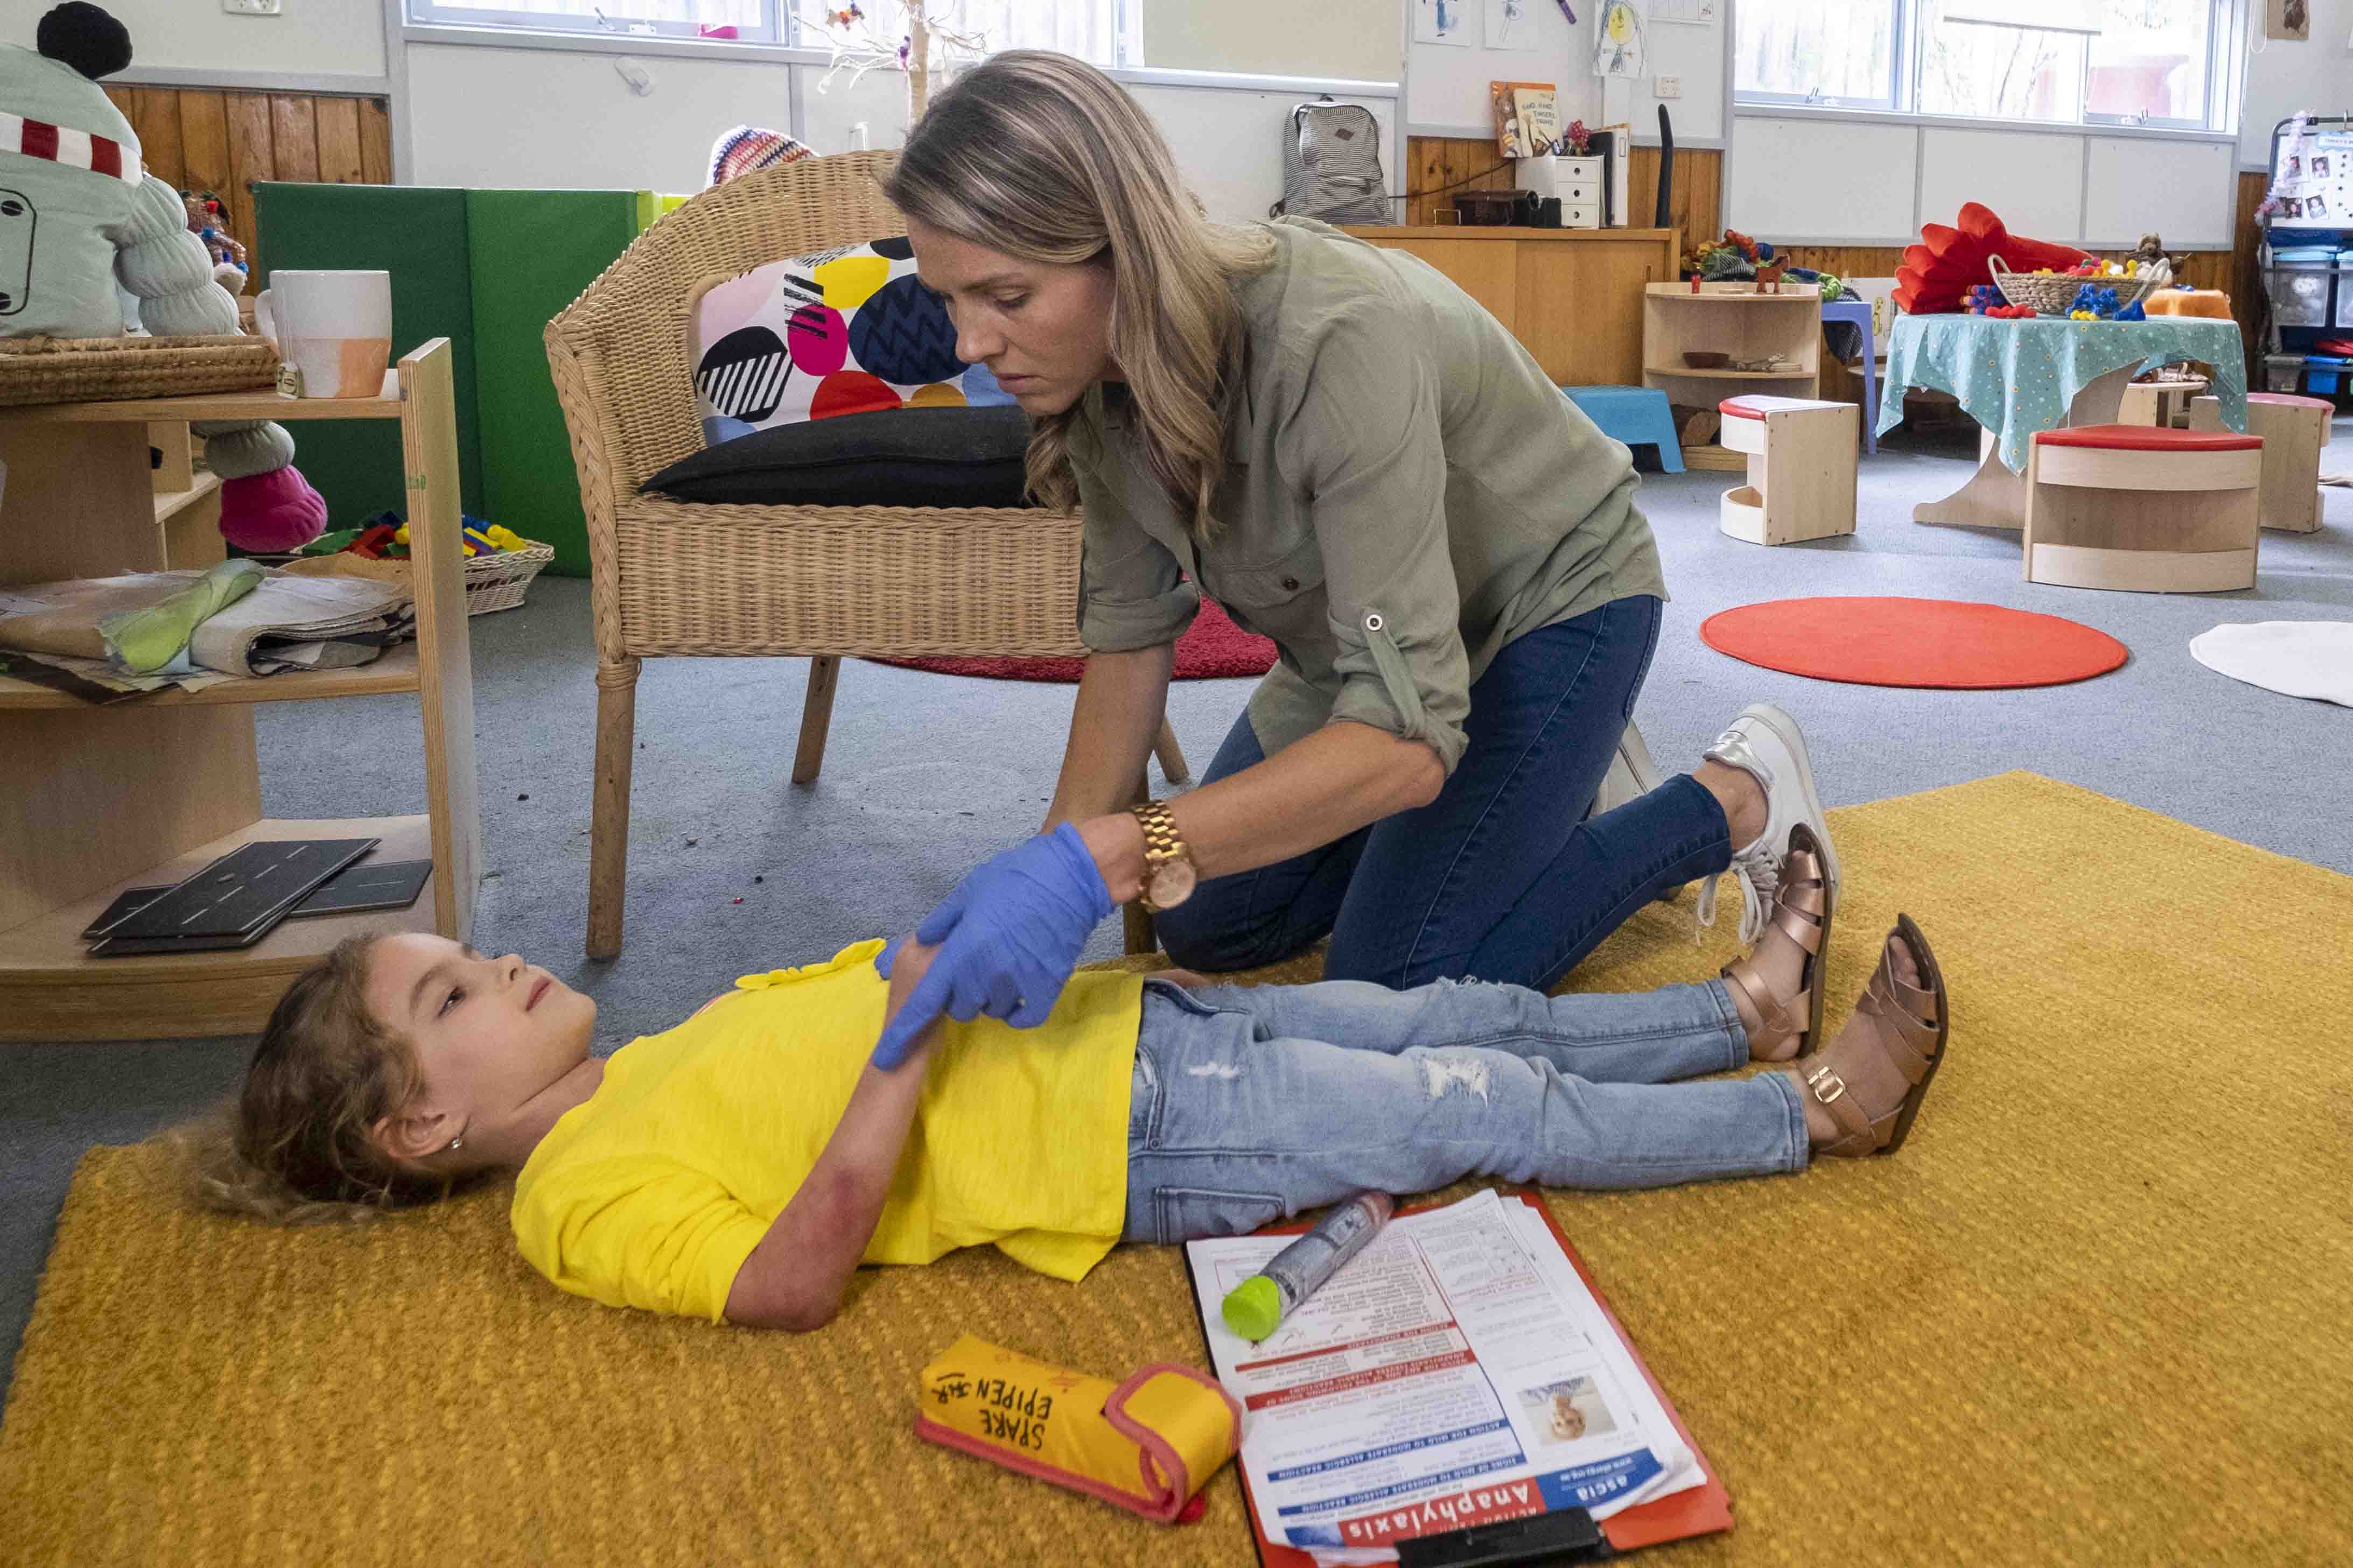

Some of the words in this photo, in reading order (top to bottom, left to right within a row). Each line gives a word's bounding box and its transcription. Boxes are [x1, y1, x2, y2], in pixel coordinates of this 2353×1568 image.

[976, 1378, 1053, 1420] EPIPEN
[978, 1409, 1045, 1451] SPARE
[1348, 1483, 1528, 1539] Anaphylaxis
